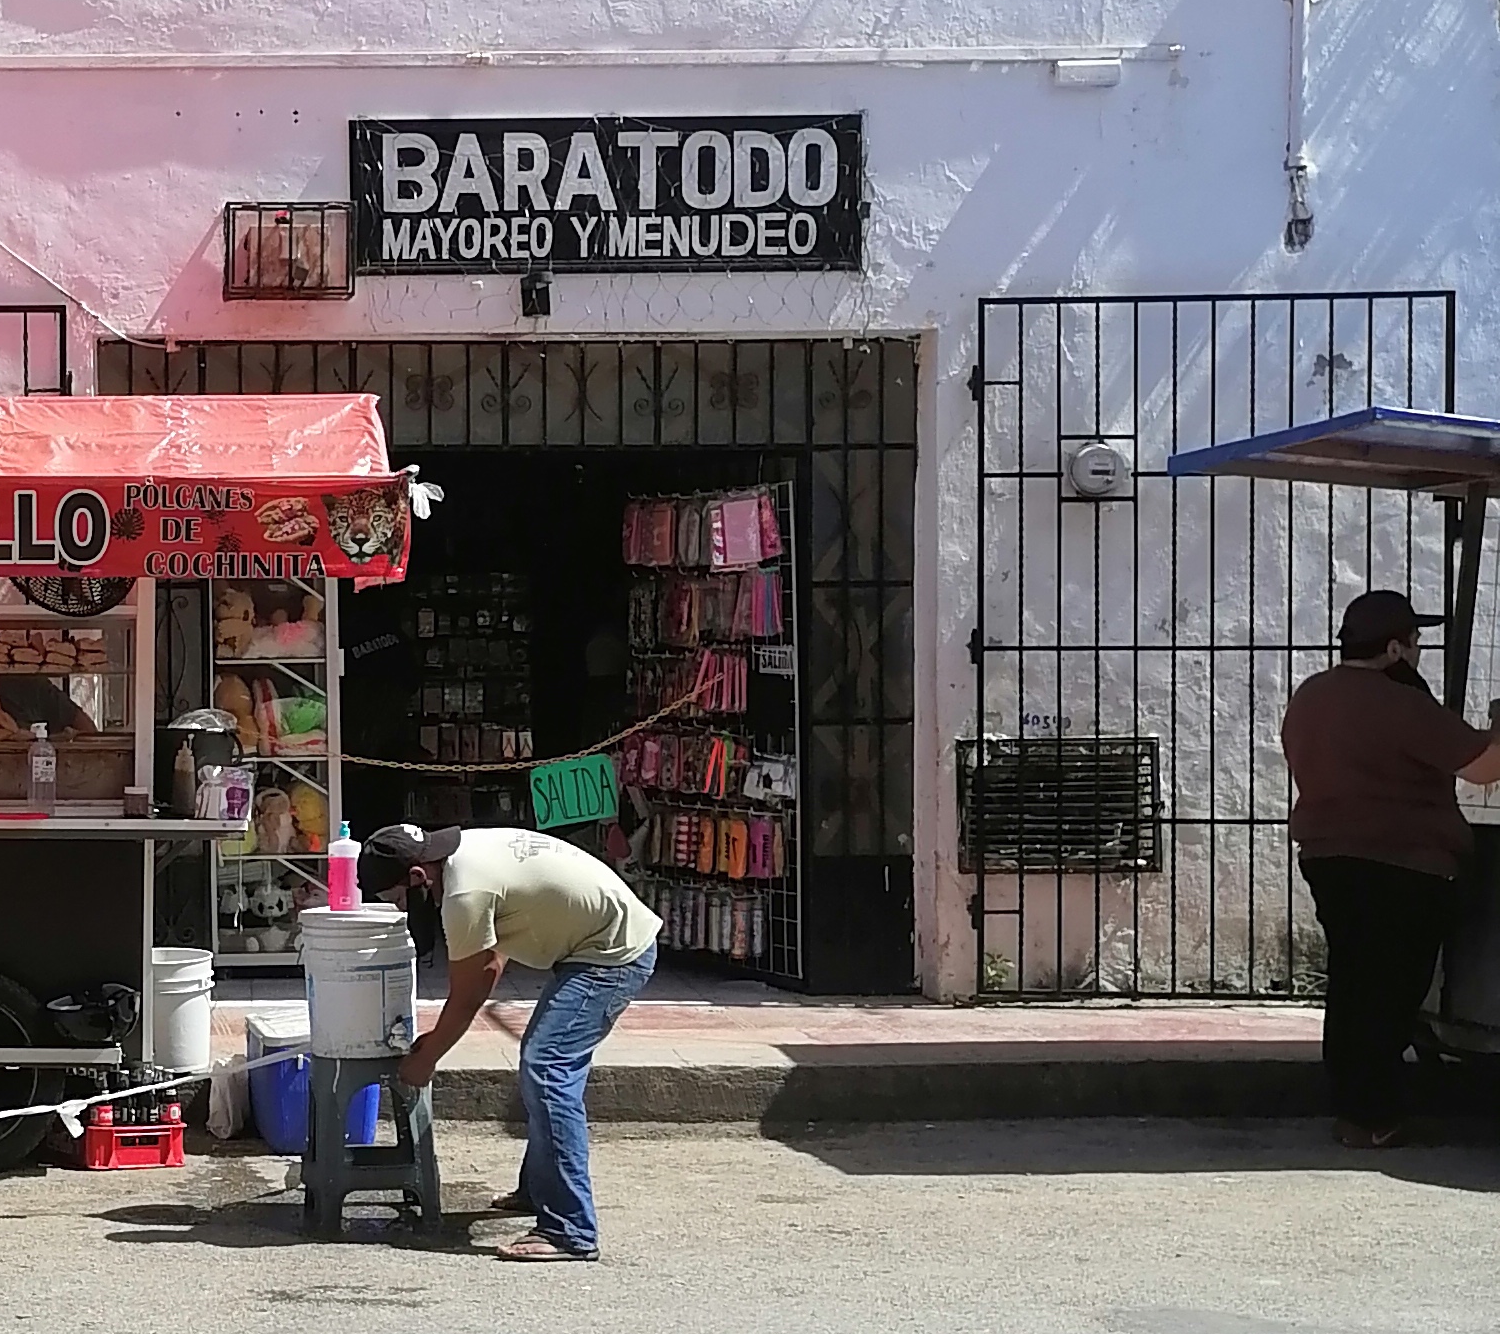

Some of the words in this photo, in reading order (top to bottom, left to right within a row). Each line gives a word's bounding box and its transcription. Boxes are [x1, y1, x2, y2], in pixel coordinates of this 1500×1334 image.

[380, 129, 840, 213] BARATODO
[381, 216, 553, 261] MAYOREO
[571, 216, 596, 259] Y
[609, 212, 818, 258] MENUDEO
[124, 483, 256, 512] POLCANES
[159, 516, 204, 544] DE
[143, 550, 328, 579] COCHINITA
[533, 763, 617, 825] SALIDA
